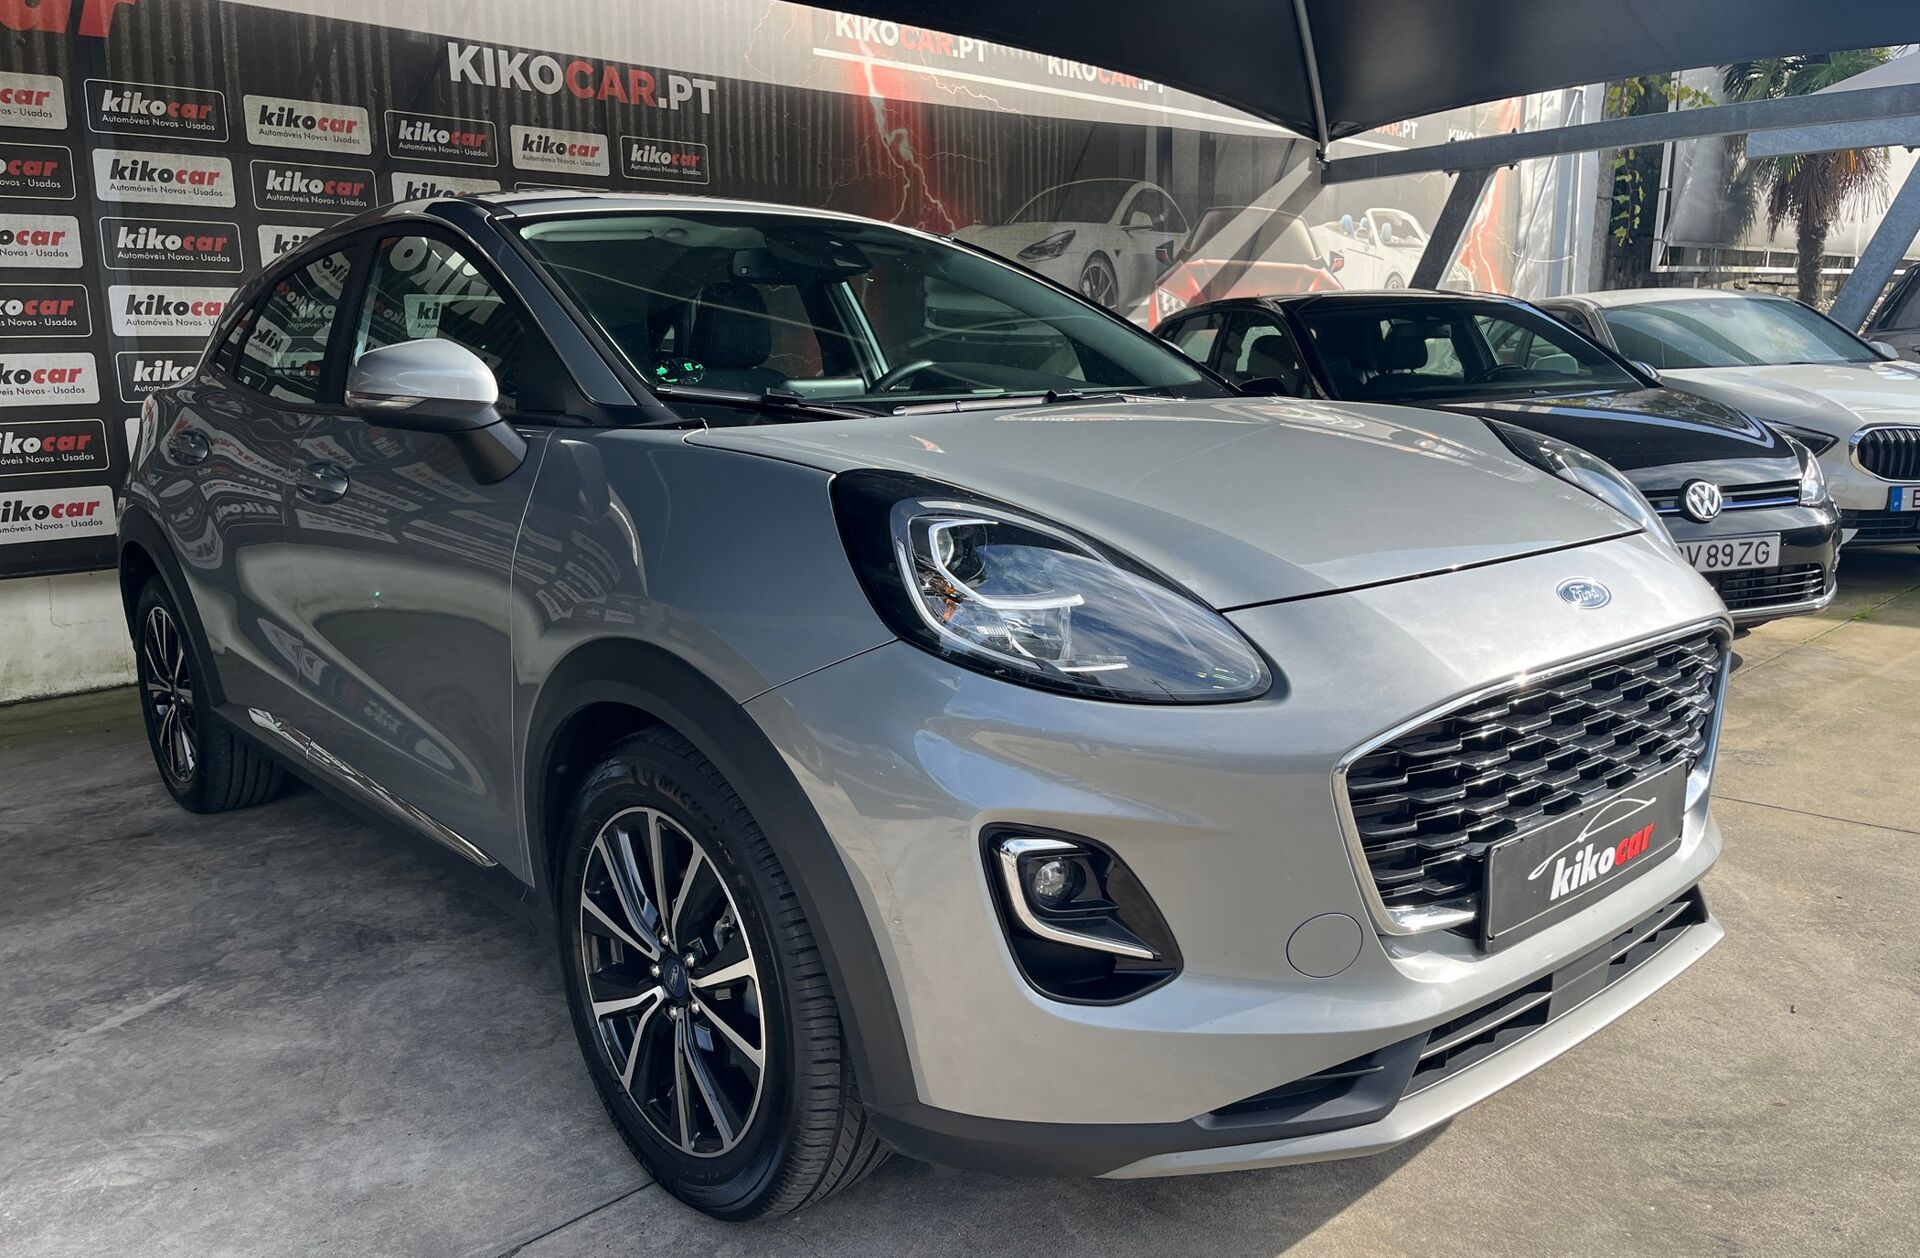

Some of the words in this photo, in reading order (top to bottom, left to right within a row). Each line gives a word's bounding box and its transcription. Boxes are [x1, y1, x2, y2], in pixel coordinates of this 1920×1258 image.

[835, 11, 988, 62] KIKOCAR.PT
[447, 41, 718, 114] KIKOCAR.PT
[19, 108, 53, 118] Usados
[101, 89, 213, 119] kikocar
[102, 114, 150, 126] Automóveis
[152, 119, 179, 128] Novos
[185, 121, 215, 131] Usados
[259, 105, 358, 134] kikocar
[398, 120, 487, 147] kikocar
[522, 134, 600, 158] kikocar
[631, 144, 701, 168] kikocar
[28, 179, 61, 188] Usados
[110, 158, 220, 186] kikocar
[266, 169, 364, 196] kikocar
[110, 183, 158, 194] Automóveis
[160, 186, 187, 195] Novos
[193, 187, 223, 197] Usados
[117, 226, 228, 251] kikocar
[36, 249, 69, 258] Usados
[117, 251, 165, 260] Automóveis
[168, 252, 194, 261] Novos
[201, 254, 230, 262] Usados
[125, 294, 225, 317] kikoca
[8, 318, 40, 327] Novos
[45, 318, 77, 327] Usados
[126, 319, 173, 327] Automóveis
[176, 319, 202, 327] Novos
[0, 363, 82, 385] kocar
[16, 387, 45, 396] Novos
[53, 386, 85, 394] Usados
[25, 455, 54, 464] Novos
[62, 453, 94, 462] Usados
[0, 500, 100, 523] ikocar
[35, 523, 63, 532] Novos
[71, 518, 103, 528] Usados
[1550, 822, 1655, 901] kikocar
